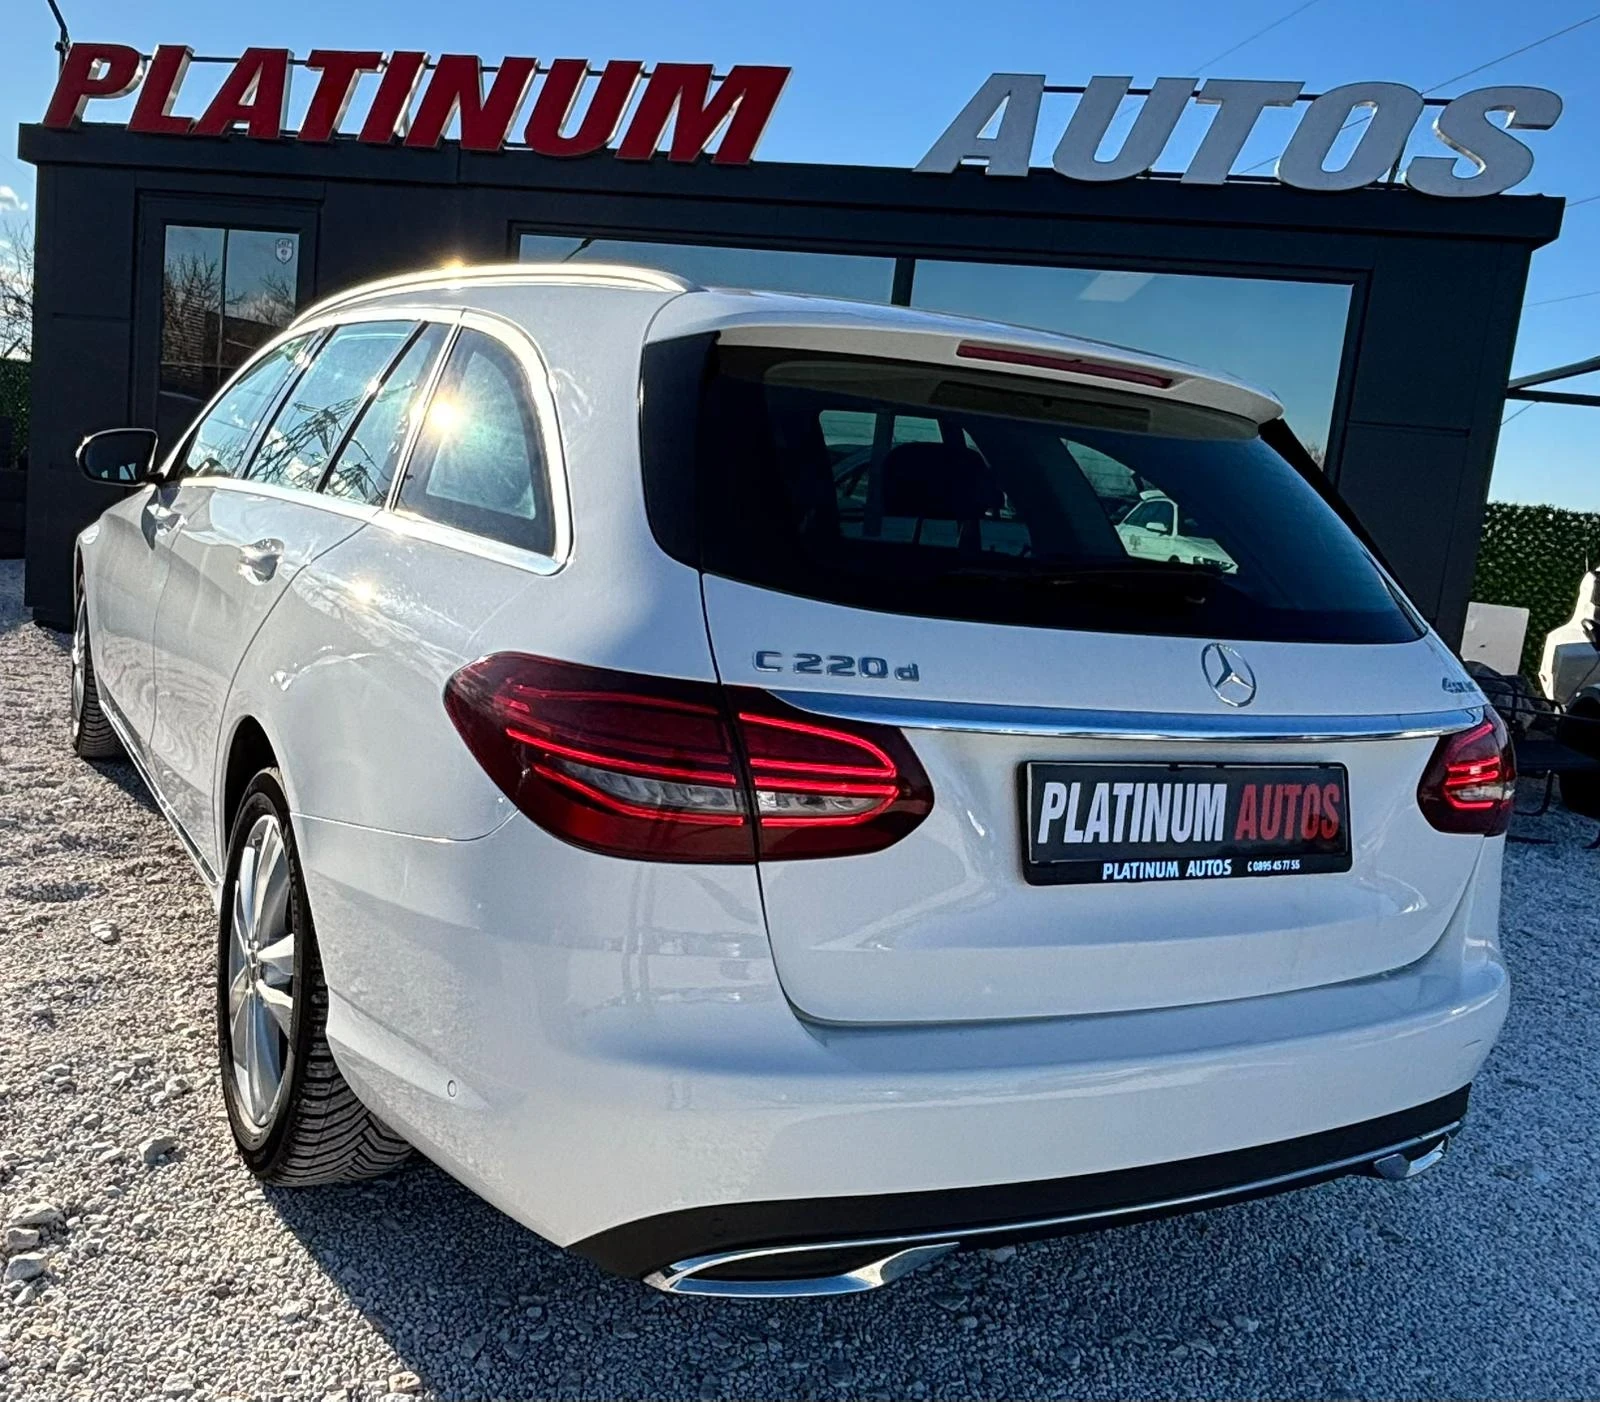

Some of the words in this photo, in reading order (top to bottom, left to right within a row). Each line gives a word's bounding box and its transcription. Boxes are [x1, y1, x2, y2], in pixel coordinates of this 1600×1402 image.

[42, 42, 793, 166] PLATINUM
[912, 72, 1564, 198] AUTOS
[753, 650, 782, 672] C
[1038, 782, 1227, 844] PLATINUM
[1235, 783, 1340, 840] AUTOS
[1102, 861, 1179, 880] PLATINUM
[1185, 859, 1232, 877] AUTOS
